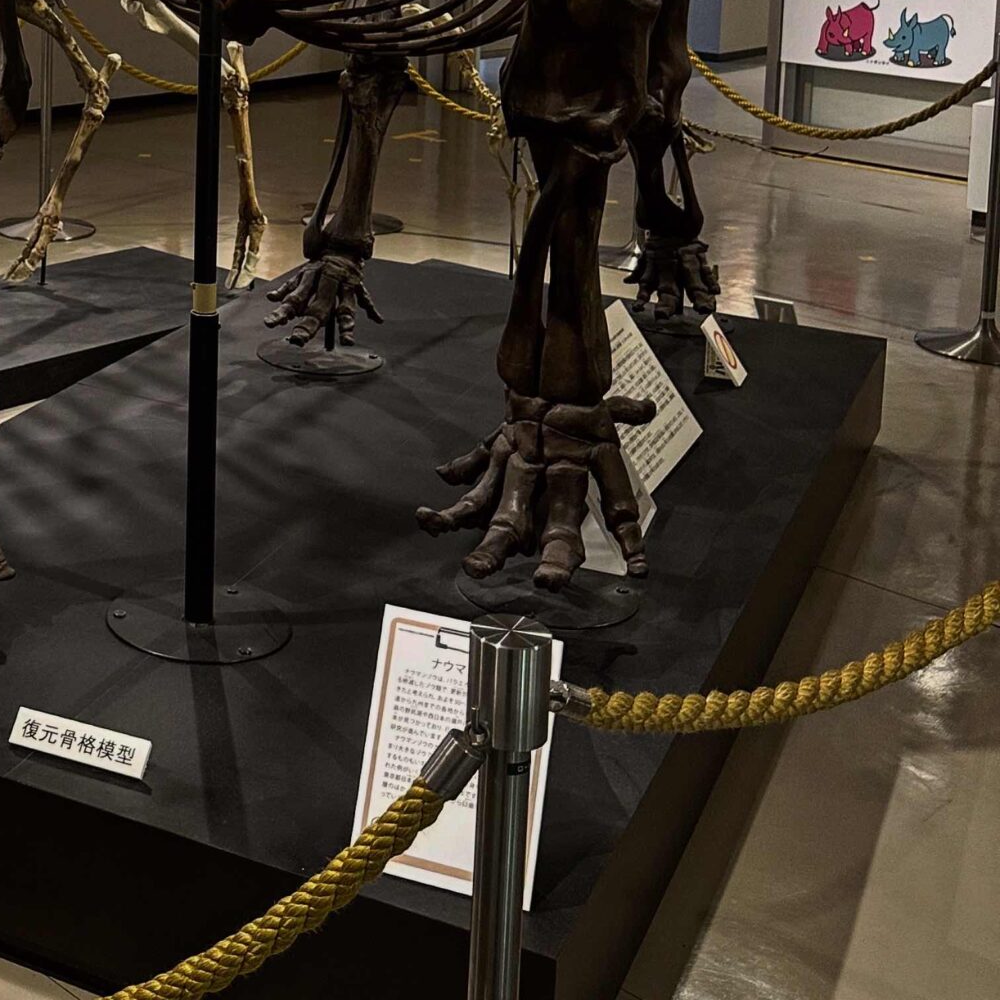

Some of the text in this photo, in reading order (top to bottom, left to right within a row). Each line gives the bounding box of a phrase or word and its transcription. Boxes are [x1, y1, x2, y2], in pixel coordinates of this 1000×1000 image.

[22, 718, 136, 766] 復元骨格模型
